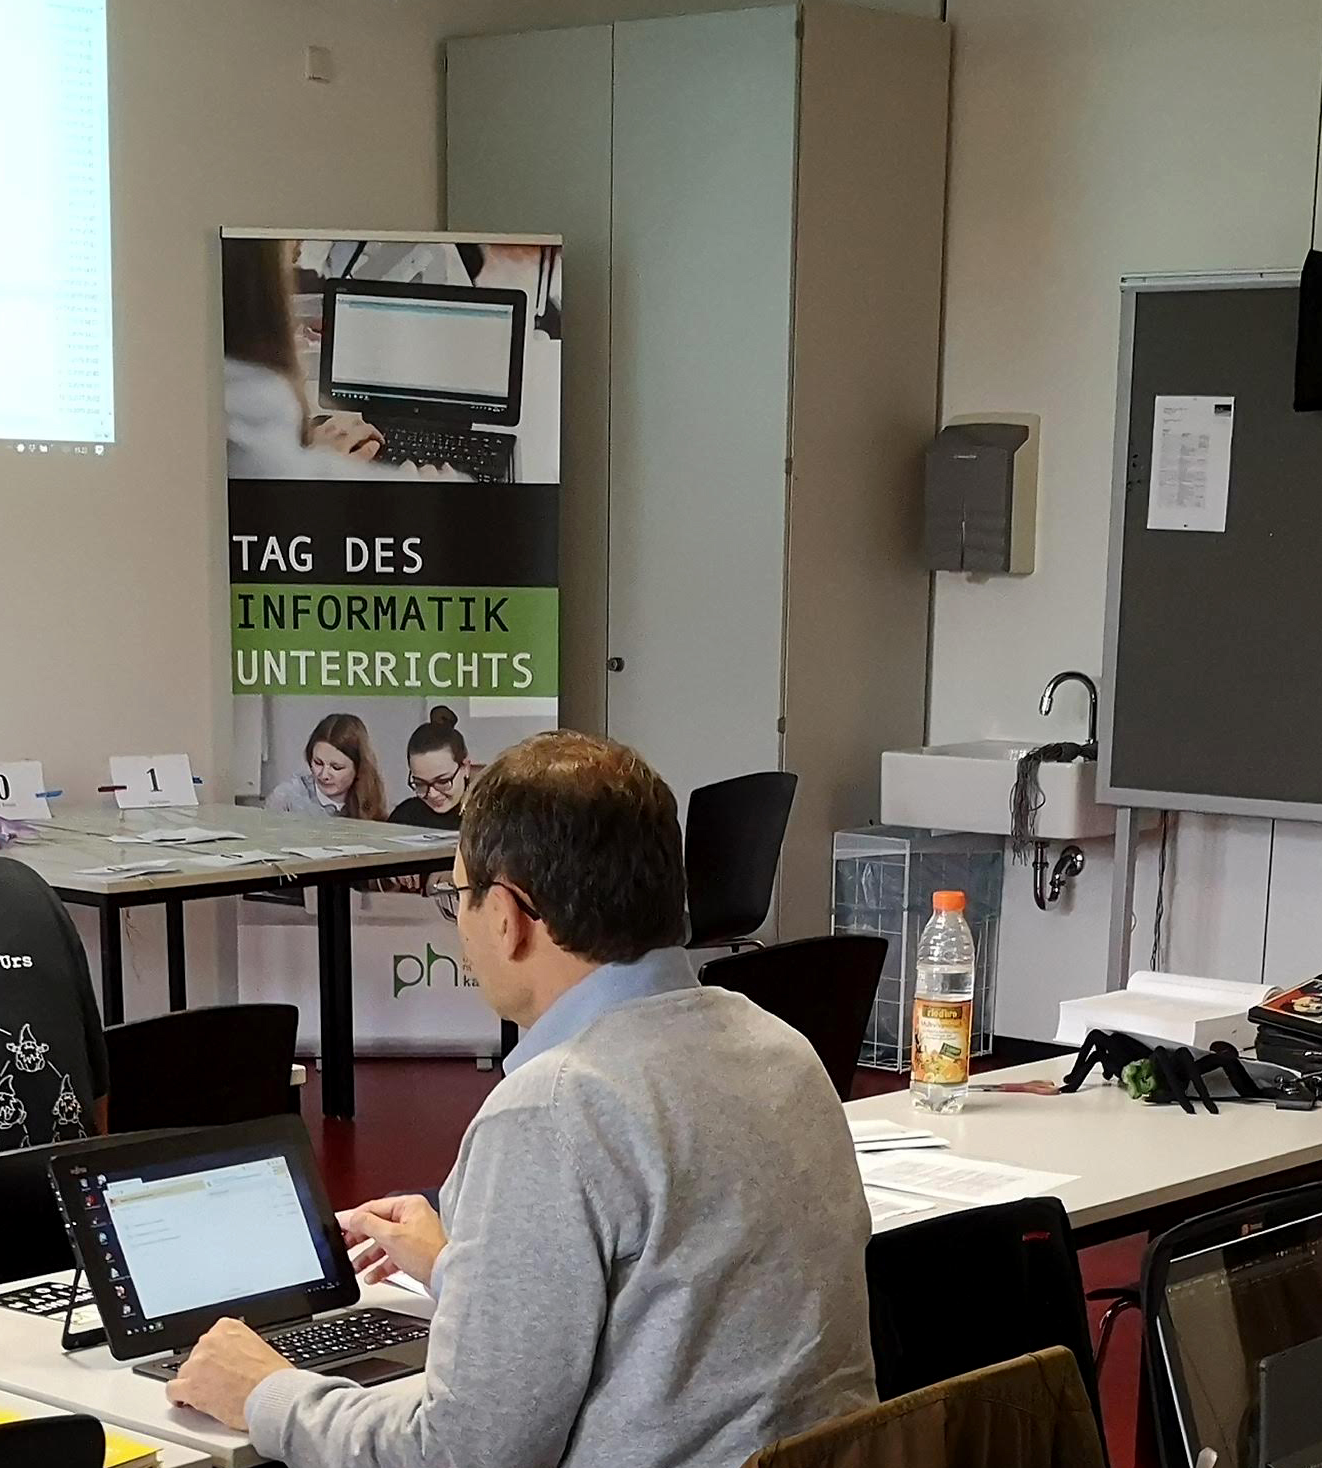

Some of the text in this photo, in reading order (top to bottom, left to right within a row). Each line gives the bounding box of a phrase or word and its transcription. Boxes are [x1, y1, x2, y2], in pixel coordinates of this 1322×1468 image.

[234, 534, 423, 574] TAG DES
[237, 594, 509, 632] INFORMATIK
[236, 649, 535, 690] UNTERRICHTS
[145, 767, 163, 793] 1
[393, 942, 458, 999] ph
[463, 974, 480, 988] ka
